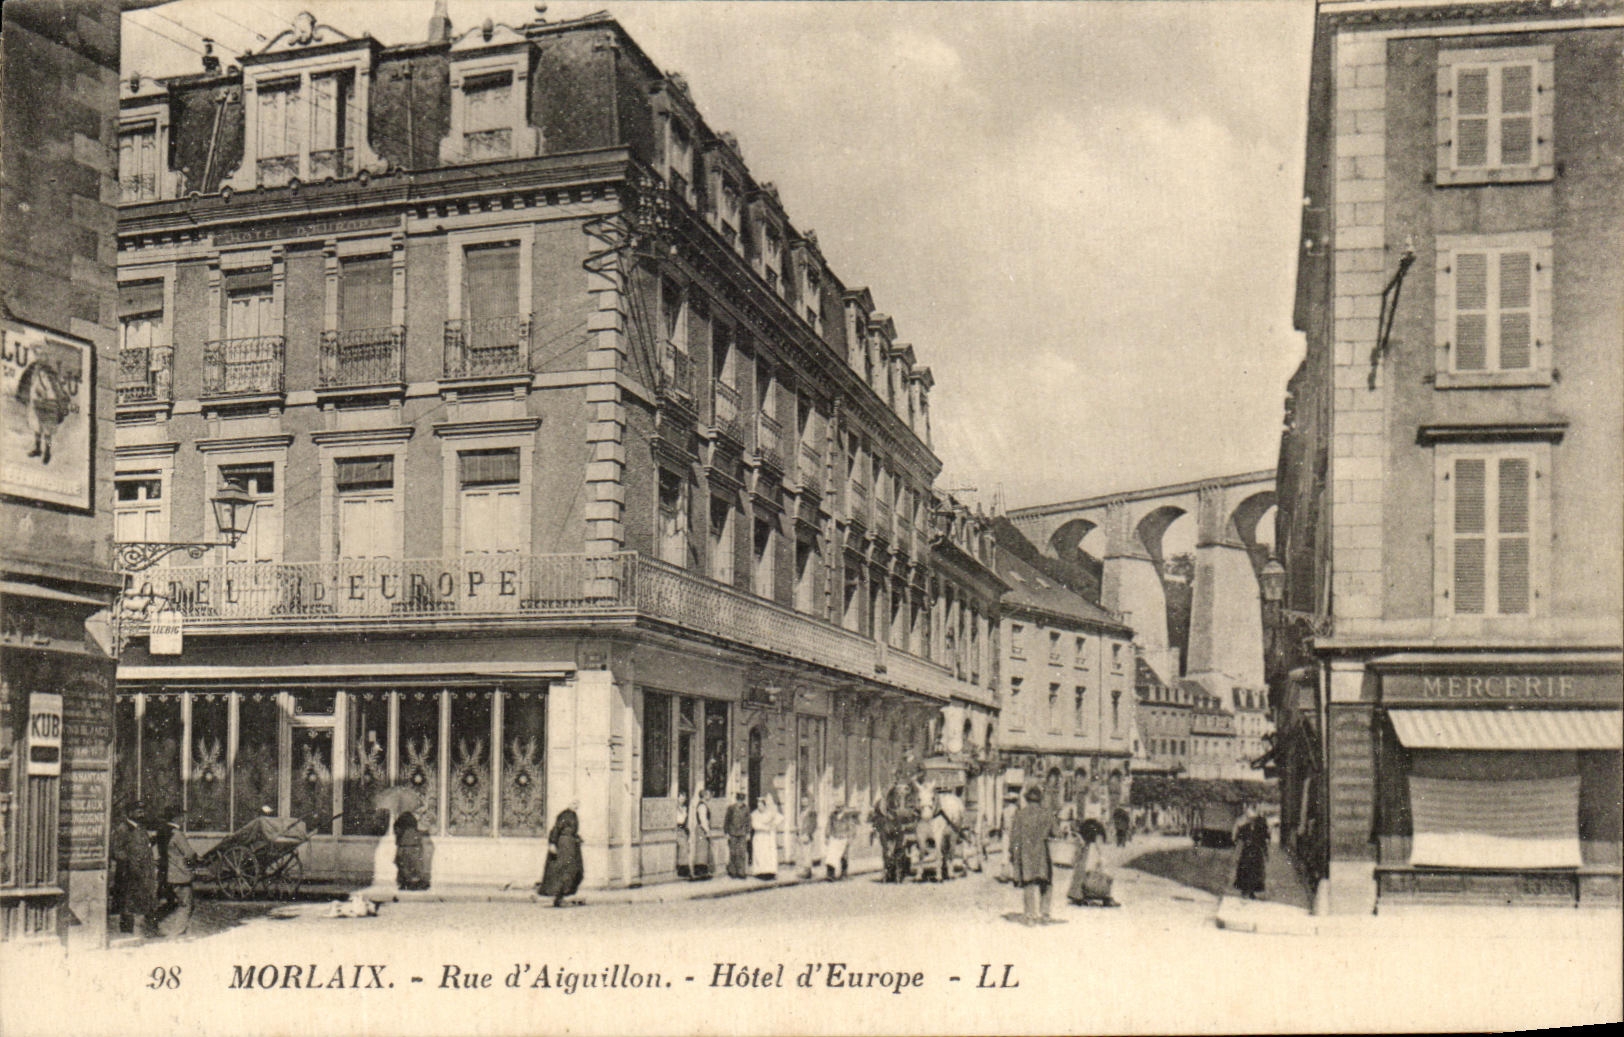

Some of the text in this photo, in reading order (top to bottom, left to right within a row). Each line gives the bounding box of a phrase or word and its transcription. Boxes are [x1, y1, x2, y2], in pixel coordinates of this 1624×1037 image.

[229, 225, 283, 243] HOTEL
[0, 329, 29, 368] LU
[151, 624, 181, 635] LIEBIG
[1422, 676, 1575, 698] MERCERIE
[31, 713, 60, 738] KUB
